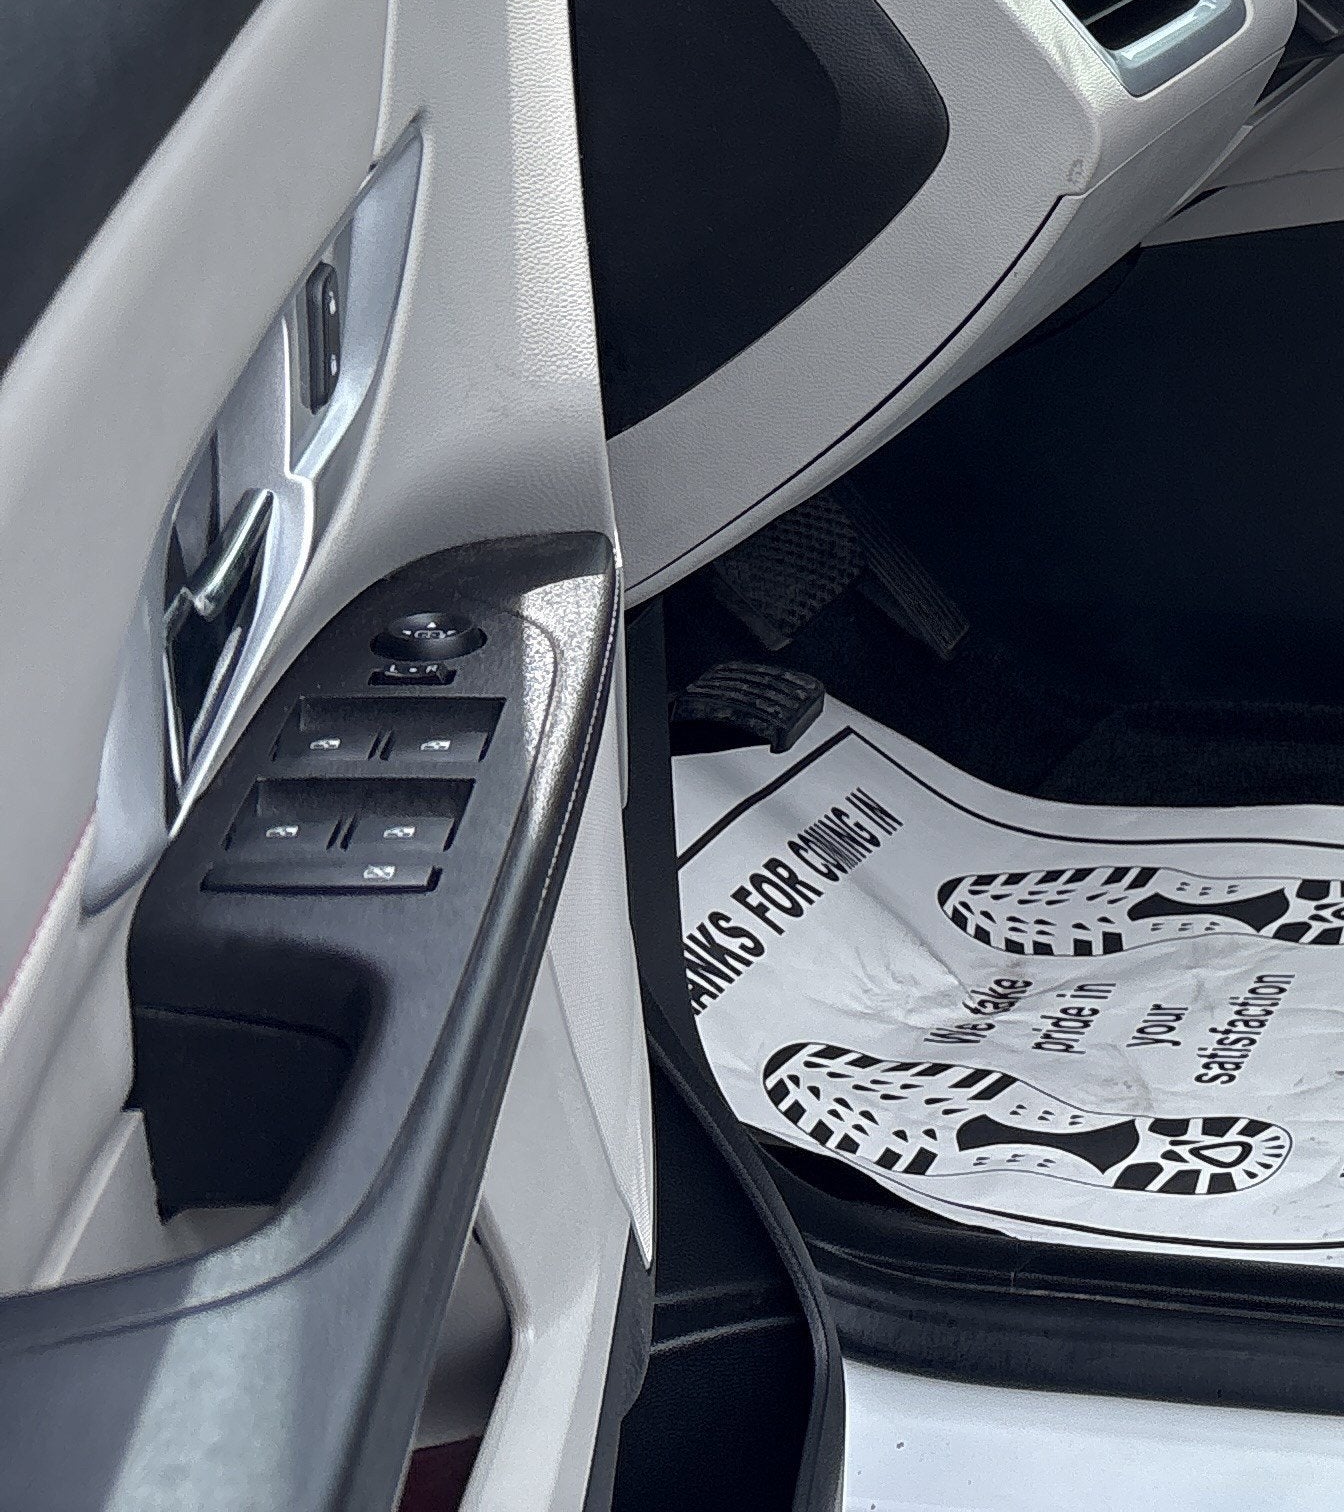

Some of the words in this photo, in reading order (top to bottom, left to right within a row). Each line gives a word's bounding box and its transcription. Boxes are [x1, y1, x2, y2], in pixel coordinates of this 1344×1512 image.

[730, 857, 825, 936] FOR
[787, 806, 881, 882] COMING
[845, 786, 904, 836] IN
[924, 1022, 996, 1044] We
[962, 978, 1034, 1015] take
[1056, 982, 1117, 1000] in
[1031, 1006, 1100, 1055] pride
[1126, 1003, 1189, 1047] your
[1194, 974, 1296, 1085] satisfaction
